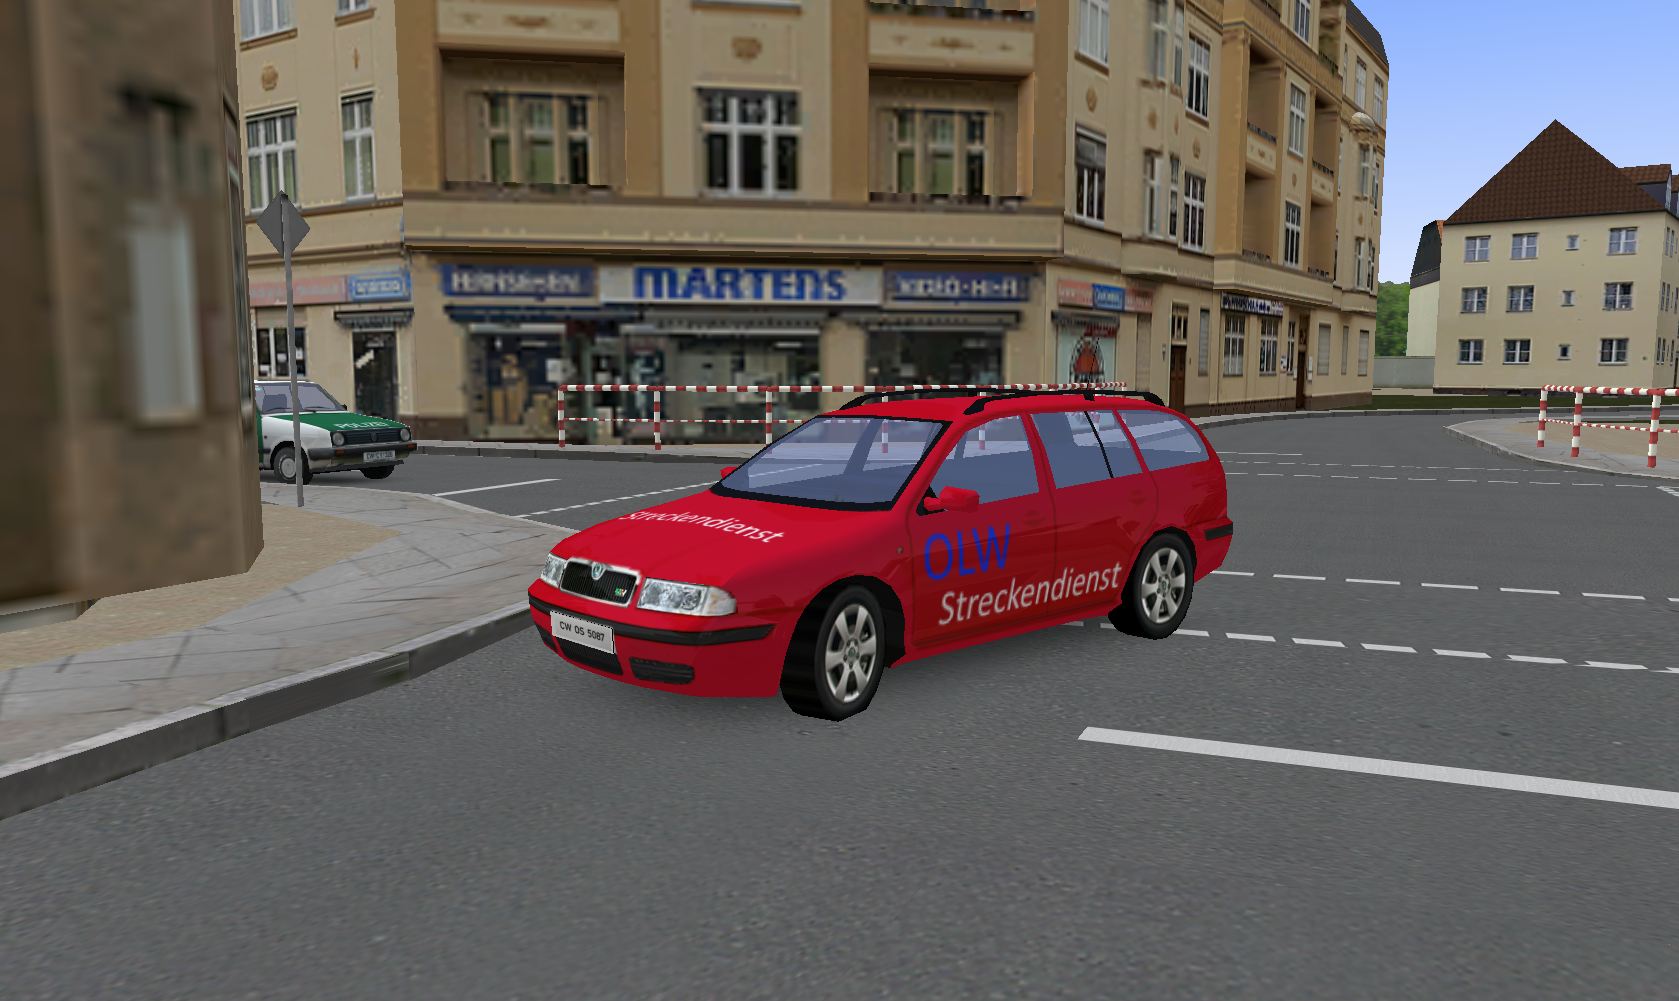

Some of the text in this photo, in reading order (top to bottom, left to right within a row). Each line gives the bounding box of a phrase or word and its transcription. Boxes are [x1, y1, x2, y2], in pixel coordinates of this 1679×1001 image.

[634, 267, 846, 301] MARTENS
[924, 523, 1011, 580] OLW
[938, 562, 1122, 625] Streckendienst
[559, 621, 572, 632] CW
[587, 629, 606, 642] 5087
